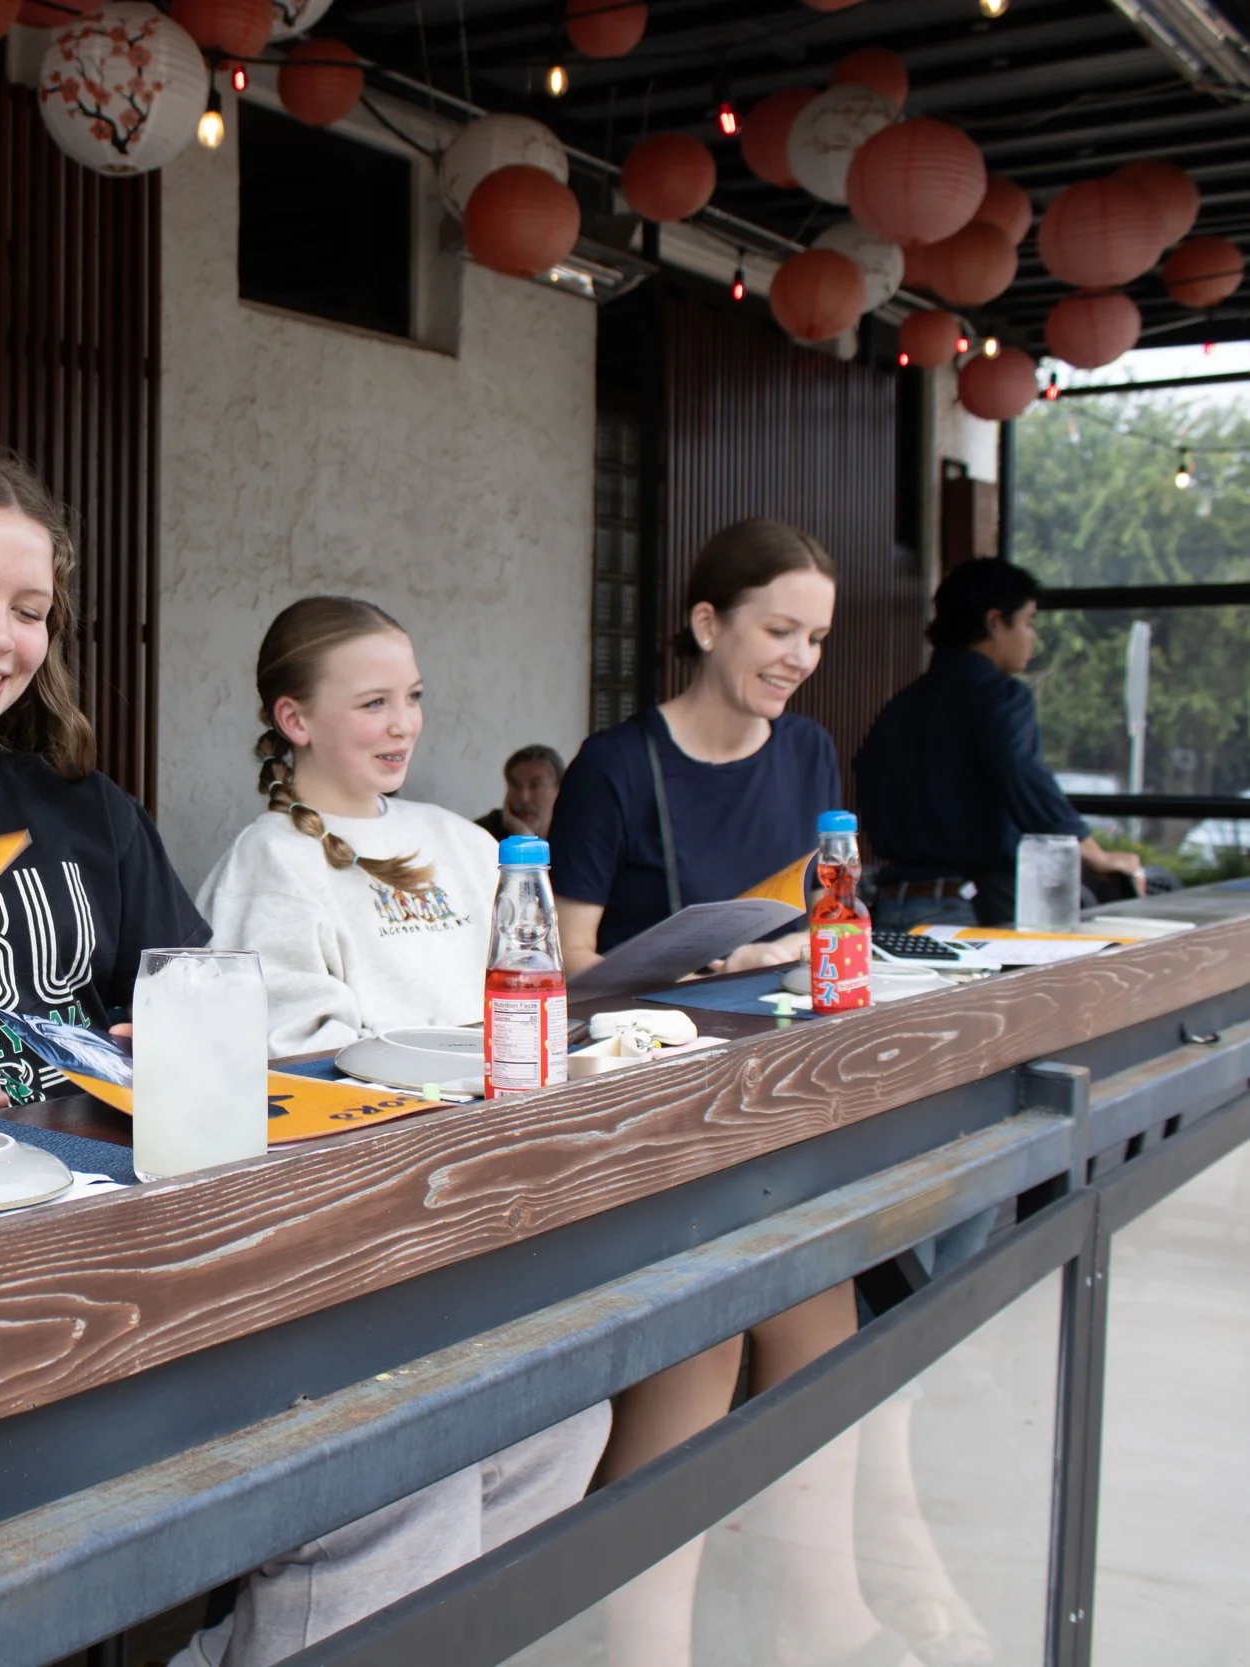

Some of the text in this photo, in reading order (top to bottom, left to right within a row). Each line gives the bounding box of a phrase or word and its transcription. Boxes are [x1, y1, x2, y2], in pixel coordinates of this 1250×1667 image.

[817, 929, 840, 1006] ラムネ
[493, 1001, 519, 1009] Nutrition
